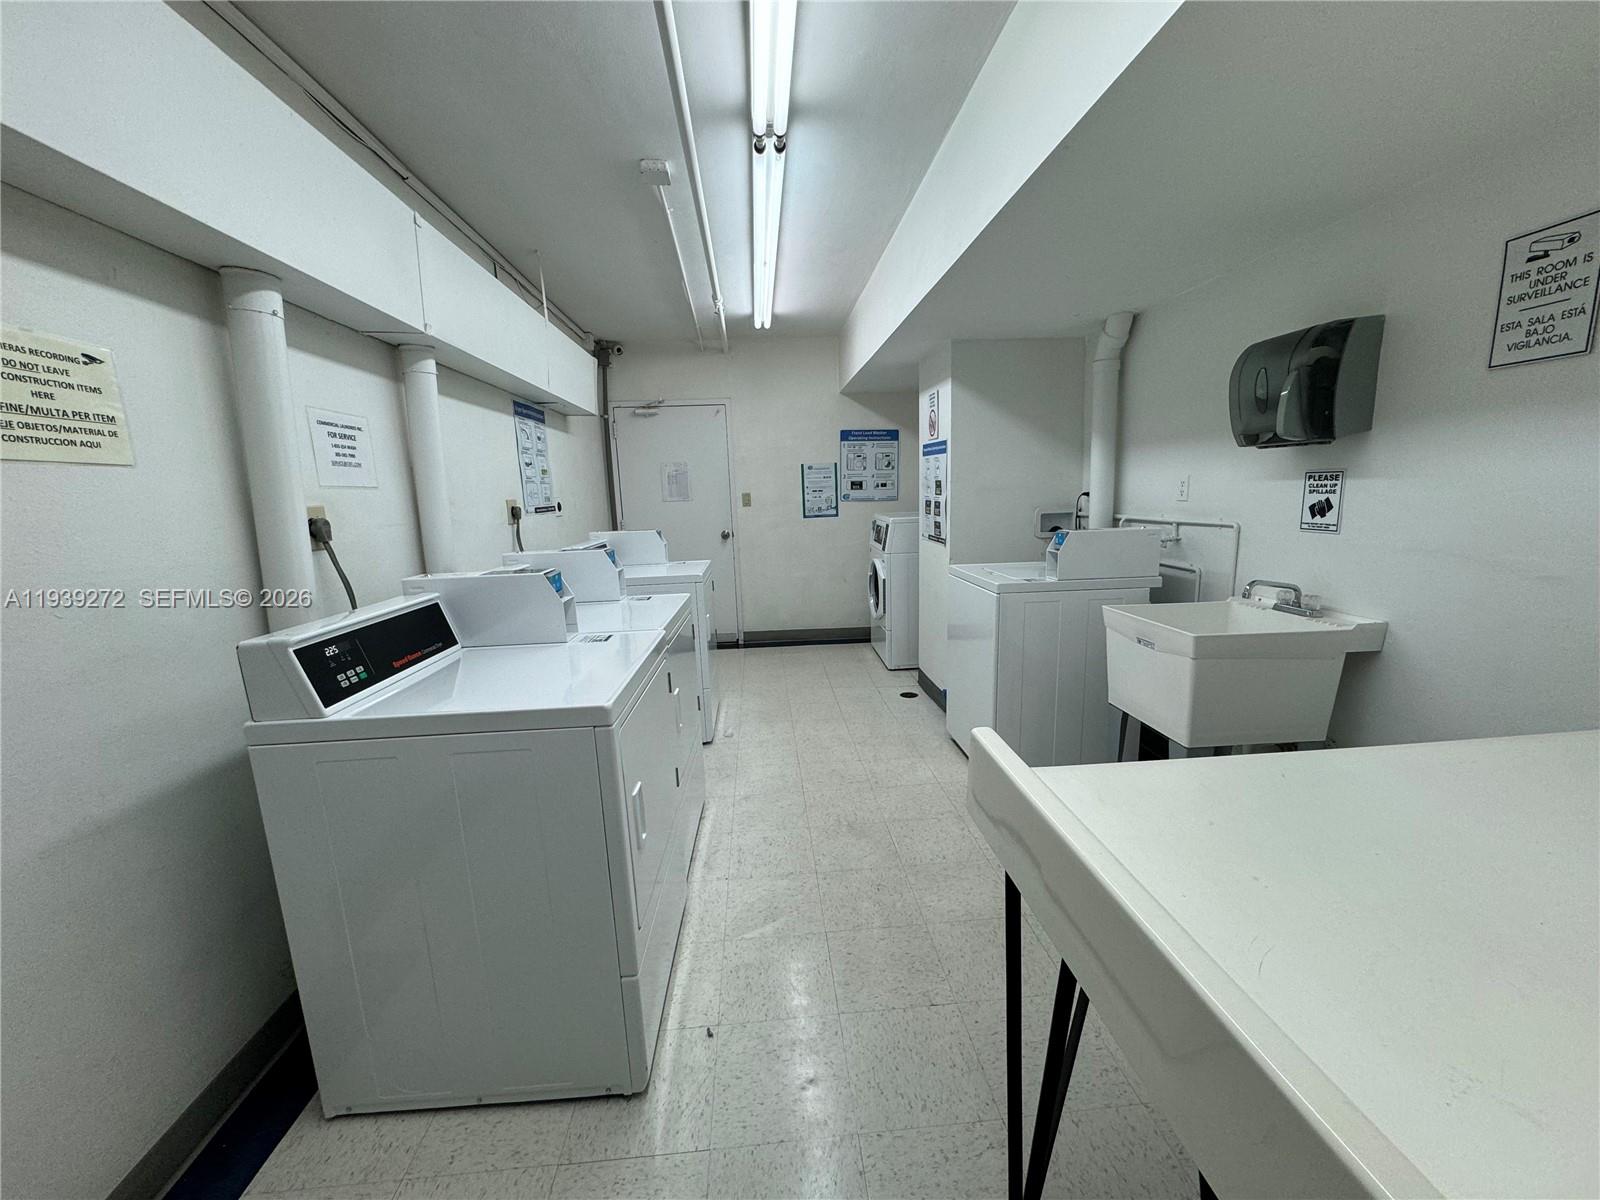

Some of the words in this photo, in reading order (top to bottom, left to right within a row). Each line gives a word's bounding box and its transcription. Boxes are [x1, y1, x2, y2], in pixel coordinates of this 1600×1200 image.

[1510, 269, 1531, 283] THIS
[1536, 256, 1577, 277] ROOM
[1583, 252, 1594, 264] IS
[1529, 271, 1568, 289] UNDER
[1506, 276, 1590, 306] SURVEILLANCE
[1500, 321, 1522, 333] ESTA
[1527, 313, 1555, 328] SALA
[1561, 303, 1586, 320] ESTÁ
[1524, 324, 1555, 338] BAJO
[1506, 332, 1573, 352] VIGILANCIA.
[28, 347, 81, 365] RECORDING
[1, 358, 17, 368] DO
[19, 360, 40, 372] NOT
[41, 365, 71, 377] LEAVE
[1, 372, 75, 390] CONSTRUCTION
[76, 384, 103, 395] ITEMS
[30, 390, 56, 401] HERE
[71, 410, 90, 421] PER
[92, 413, 116, 424] ITEM
[16, 421, 107, 437] OBJETOS/MATERIAL
[108, 429, 119, 438] DE
[338, 433, 357, 441] SERVICE
[1, 434, 77, 447] CONSTRUCCION
[79, 440, 102, 449] AQUI
[1308, 474, 1340, 482] PLEASE
[324, 644, 339, 657] 225
